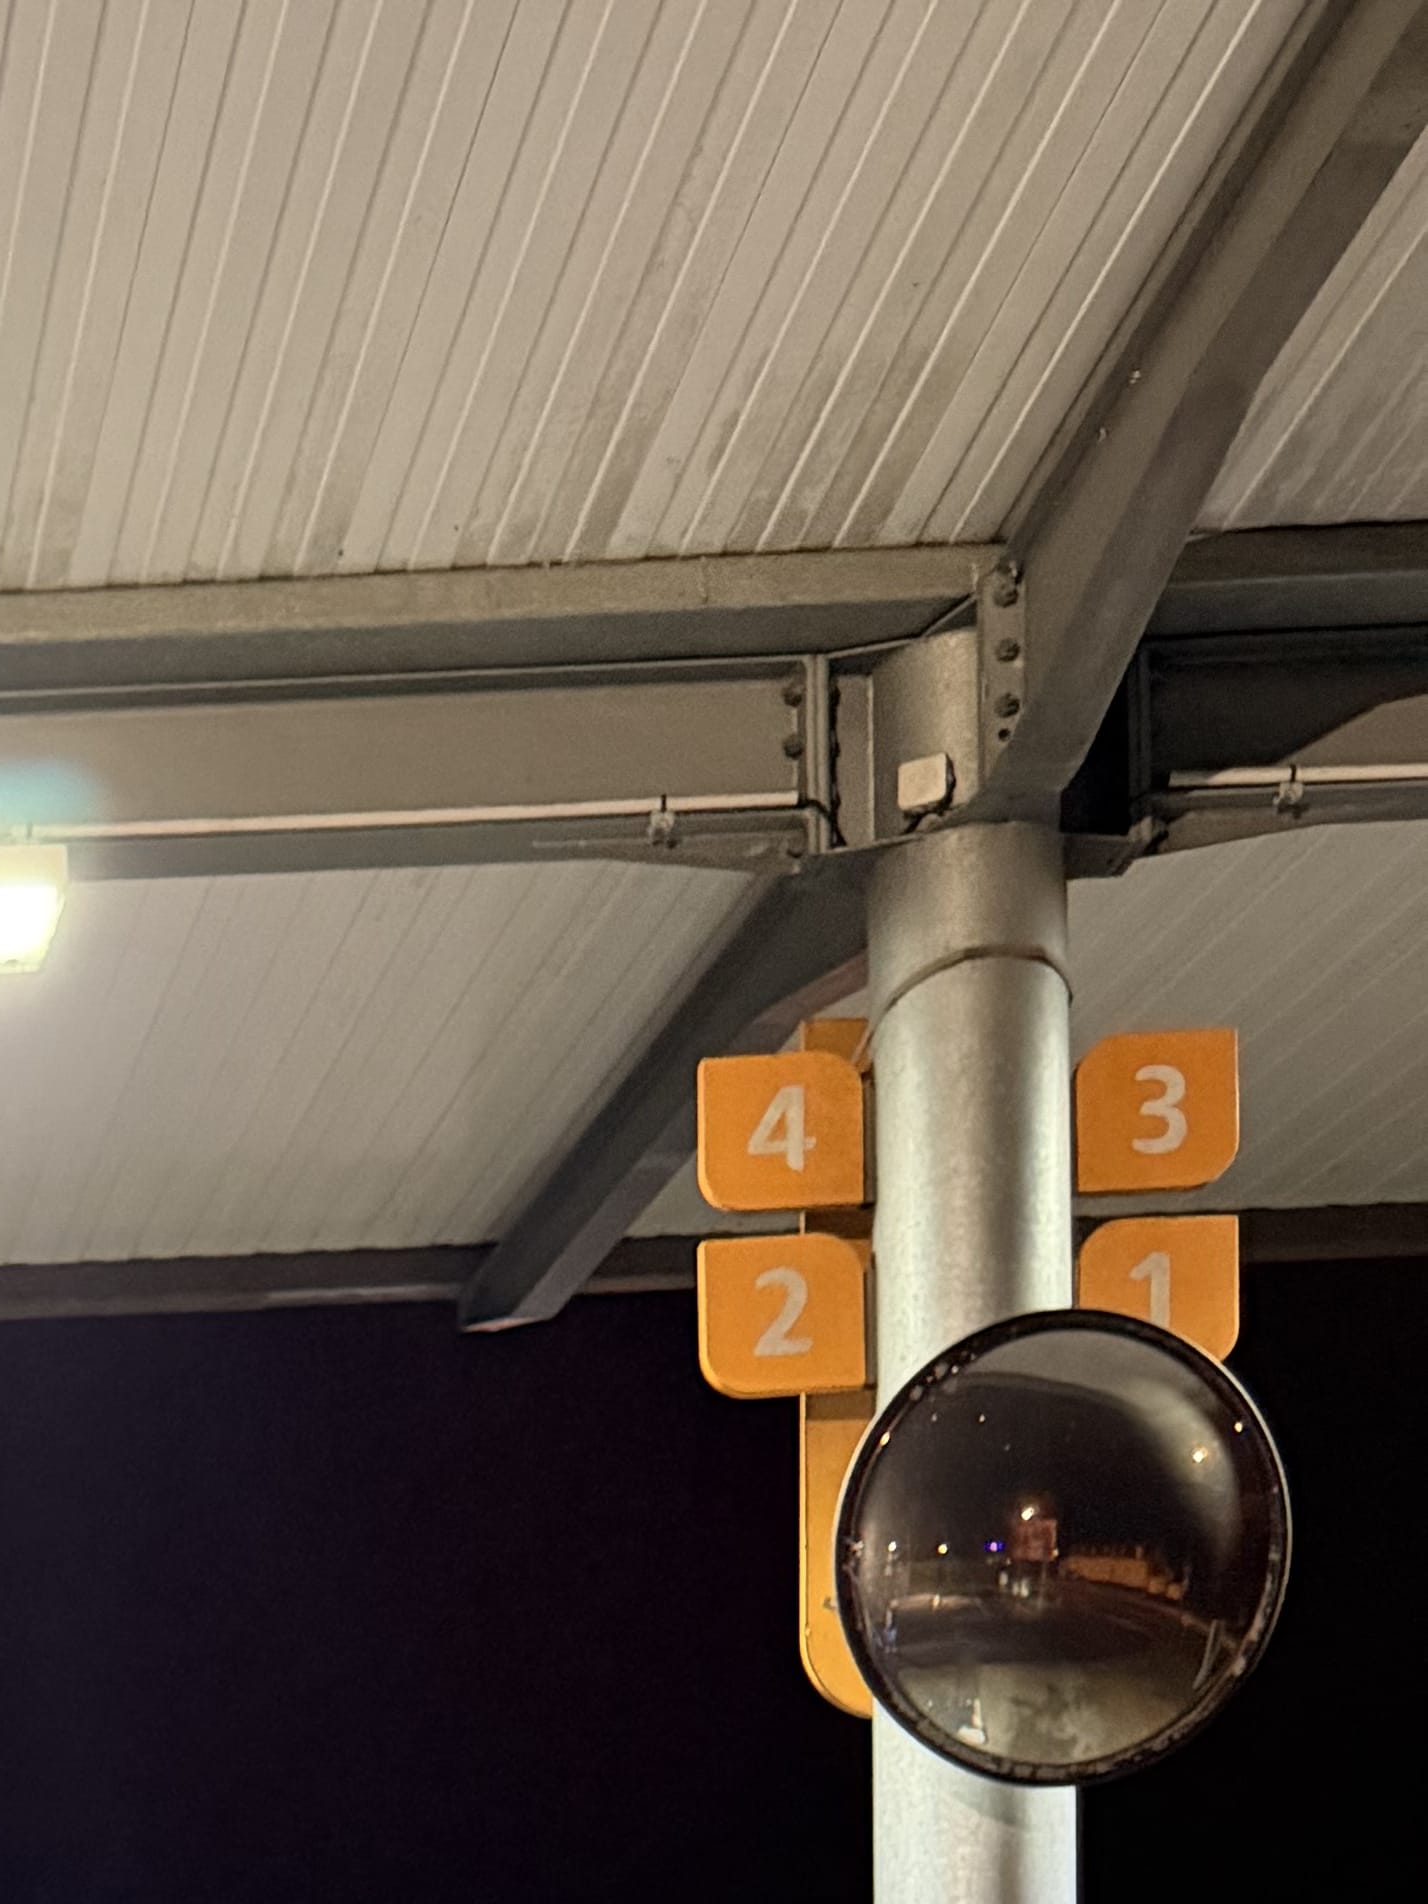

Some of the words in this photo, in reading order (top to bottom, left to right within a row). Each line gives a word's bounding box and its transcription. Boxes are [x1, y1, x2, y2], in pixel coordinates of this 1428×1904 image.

[747, 1083, 817, 1172] 4
[1131, 1064, 1188, 1155] 3
[752, 1265, 814, 1358] 2
[1128, 1250, 1172, 1327] 1
